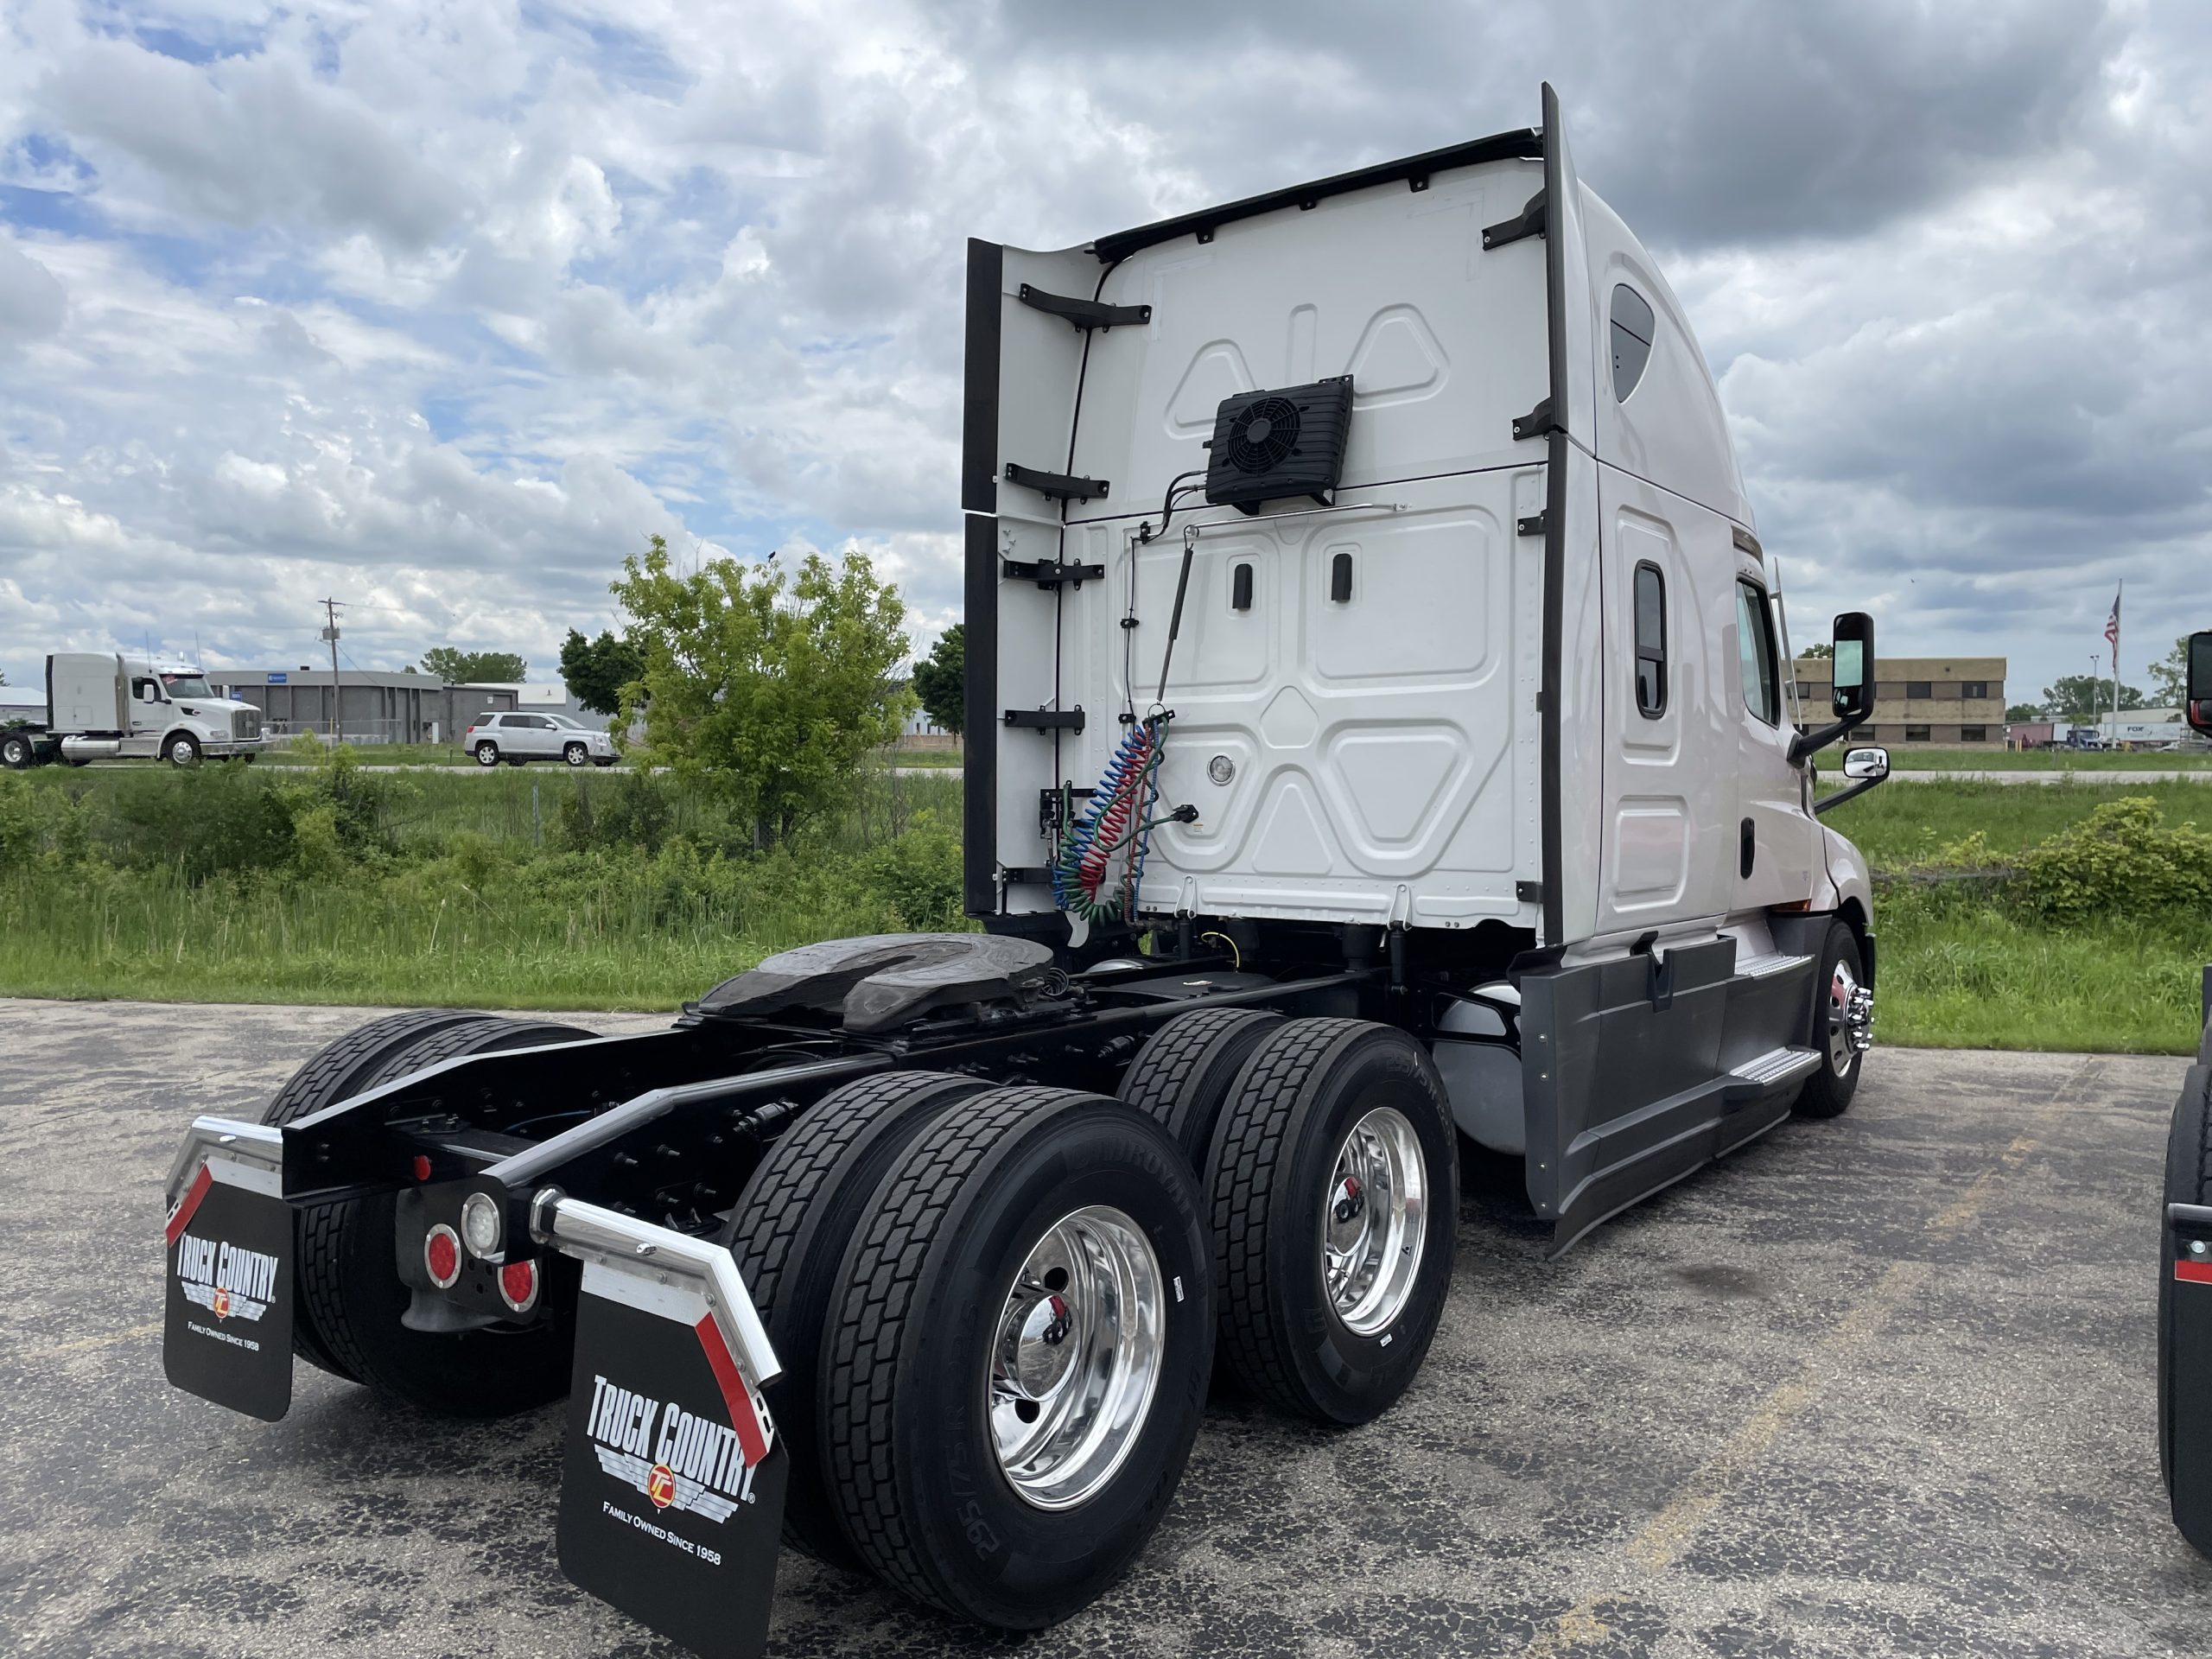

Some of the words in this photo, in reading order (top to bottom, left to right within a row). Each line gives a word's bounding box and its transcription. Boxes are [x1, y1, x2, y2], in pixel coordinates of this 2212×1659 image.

[177, 1231, 217, 1286] TRUCK
[216, 1241, 278, 1302] COUNTRY
[188, 1321, 207, 1334] FAMILY
[206, 1327, 226, 1341] OWNED
[226, 1333, 243, 1347] SINCE
[244, 1339, 259, 1351] 1958
[587, 1374, 659, 1459] TRUCK
[602, 1501, 633, 1524] FAMILY
[632, 1516, 666, 1540] OWNED
[666, 1531, 695, 1554] SINCE
[696, 1544, 721, 1566] 1958
